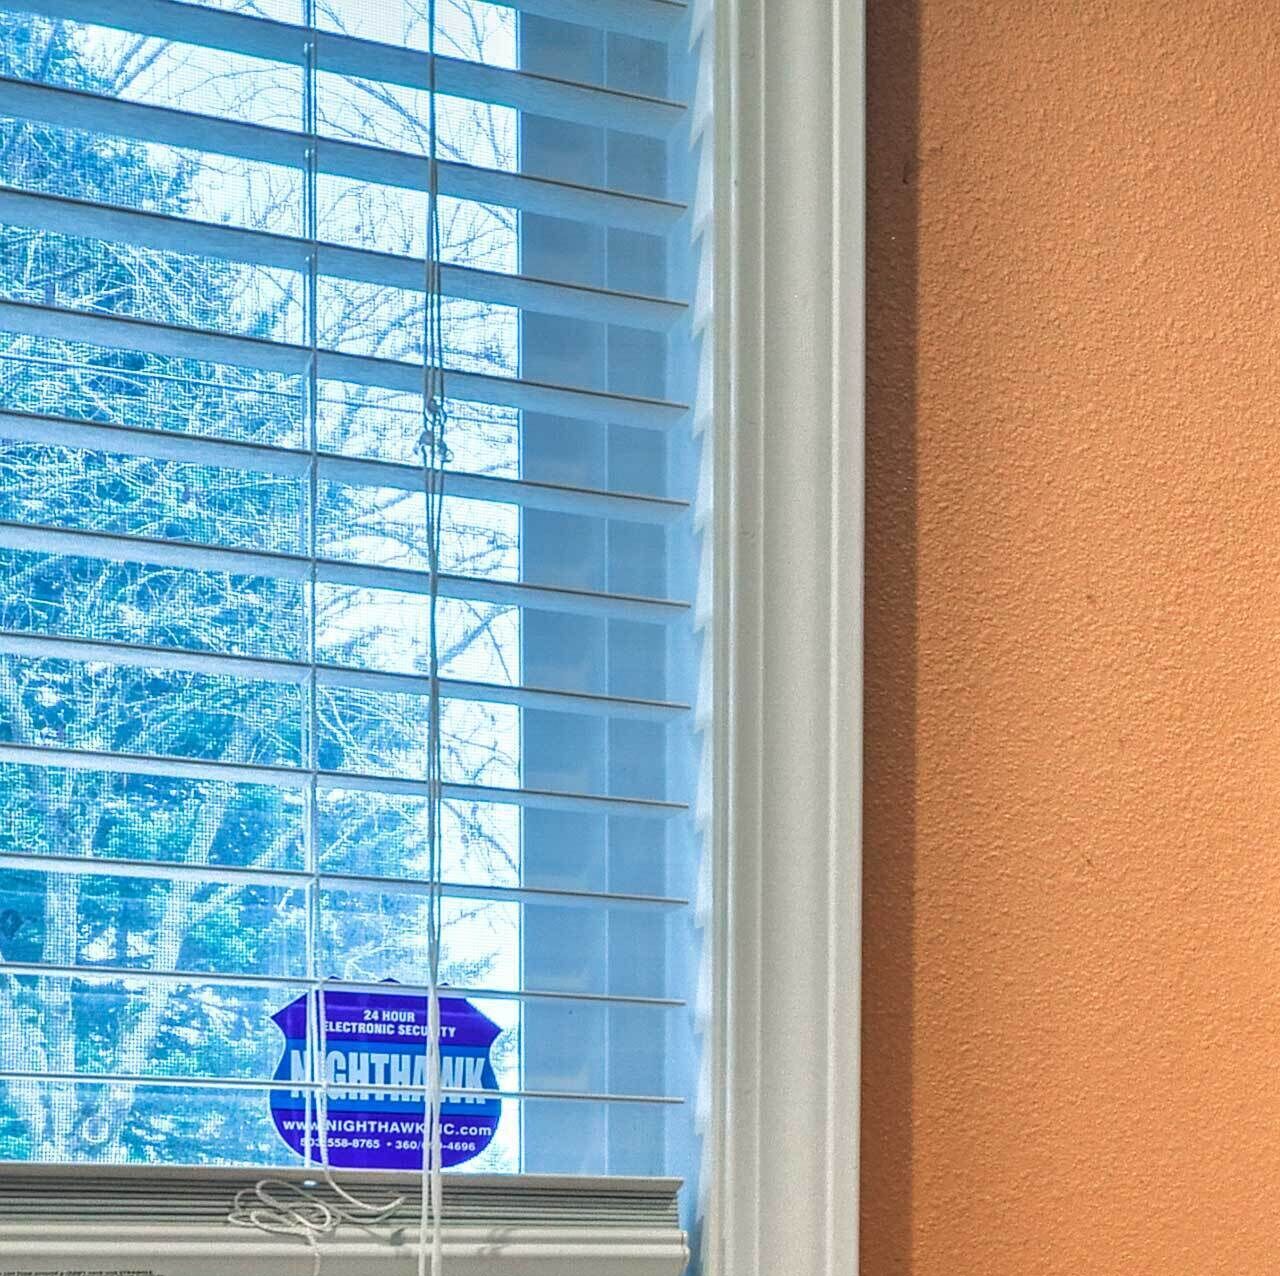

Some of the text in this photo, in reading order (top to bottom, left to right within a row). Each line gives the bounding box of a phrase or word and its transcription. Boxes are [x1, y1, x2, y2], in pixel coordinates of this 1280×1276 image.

[364, 1010, 416, 1023] 24 HOUR
[324, 1021, 456, 1038] ELECTRONIC SECUTY
[290, 1050, 486, 1104] NGHTHAWK
